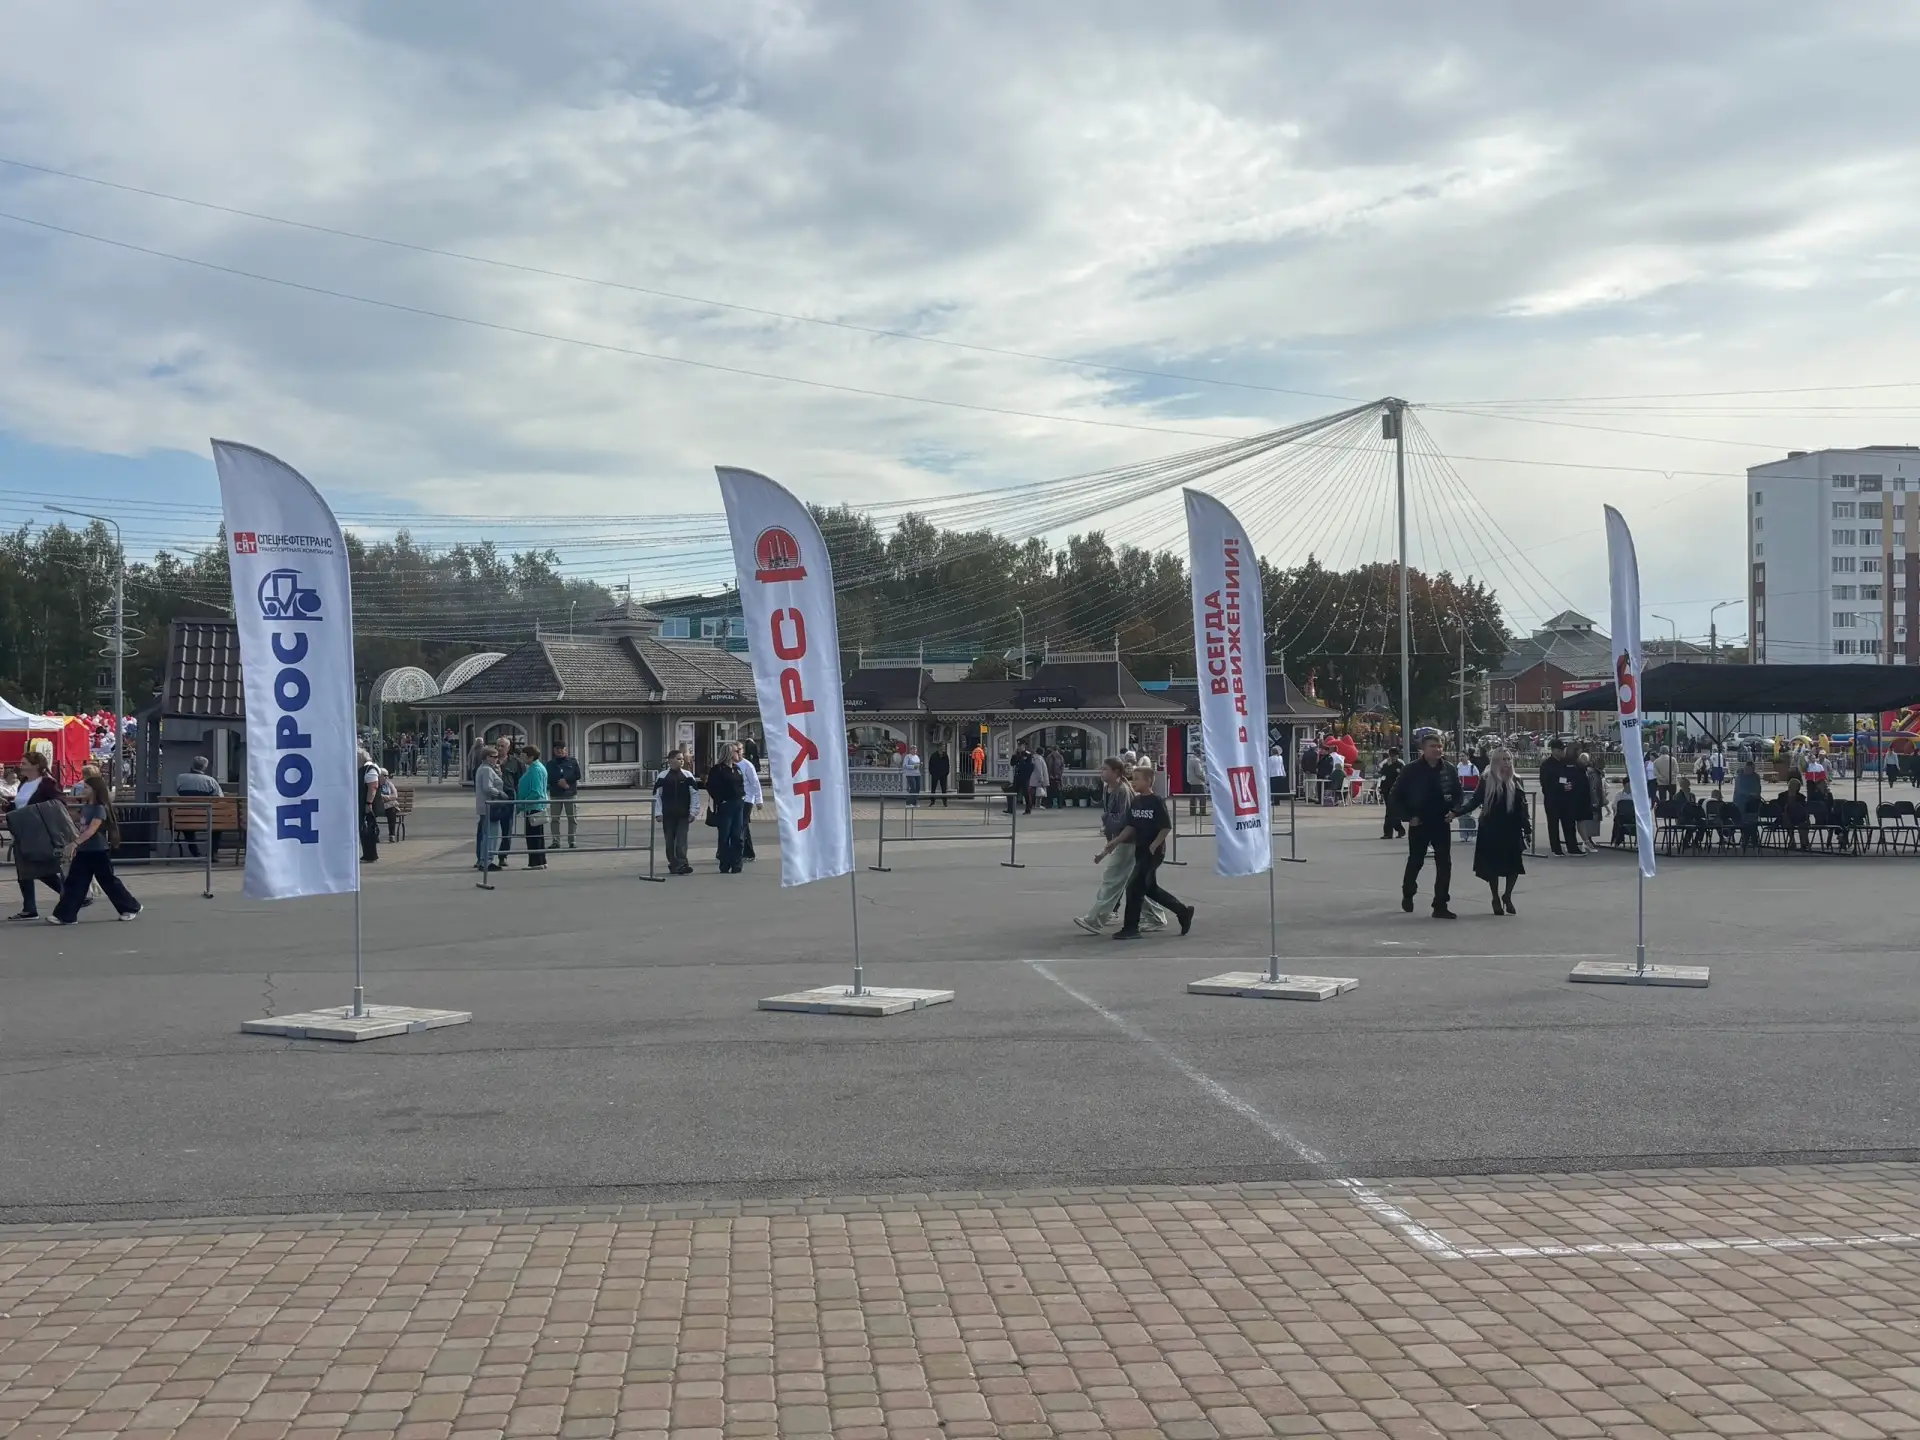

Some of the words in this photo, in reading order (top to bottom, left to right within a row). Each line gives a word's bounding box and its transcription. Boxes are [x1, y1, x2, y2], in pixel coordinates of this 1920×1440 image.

[257, 534, 332, 548] СПЕЦНЕФТЕТРАНС
[1204, 590, 1229, 695] ВСЕГДА
[1224, 538, 1248, 716] ДВИЖЕНИИ!
[271, 631, 319, 844] ДОРОС
[770, 606, 821, 831] ЧУРС
[1622, 719, 1639, 728] ЧЕР
[1236, 818, 1262, 831] ЛУКОЙЛ
